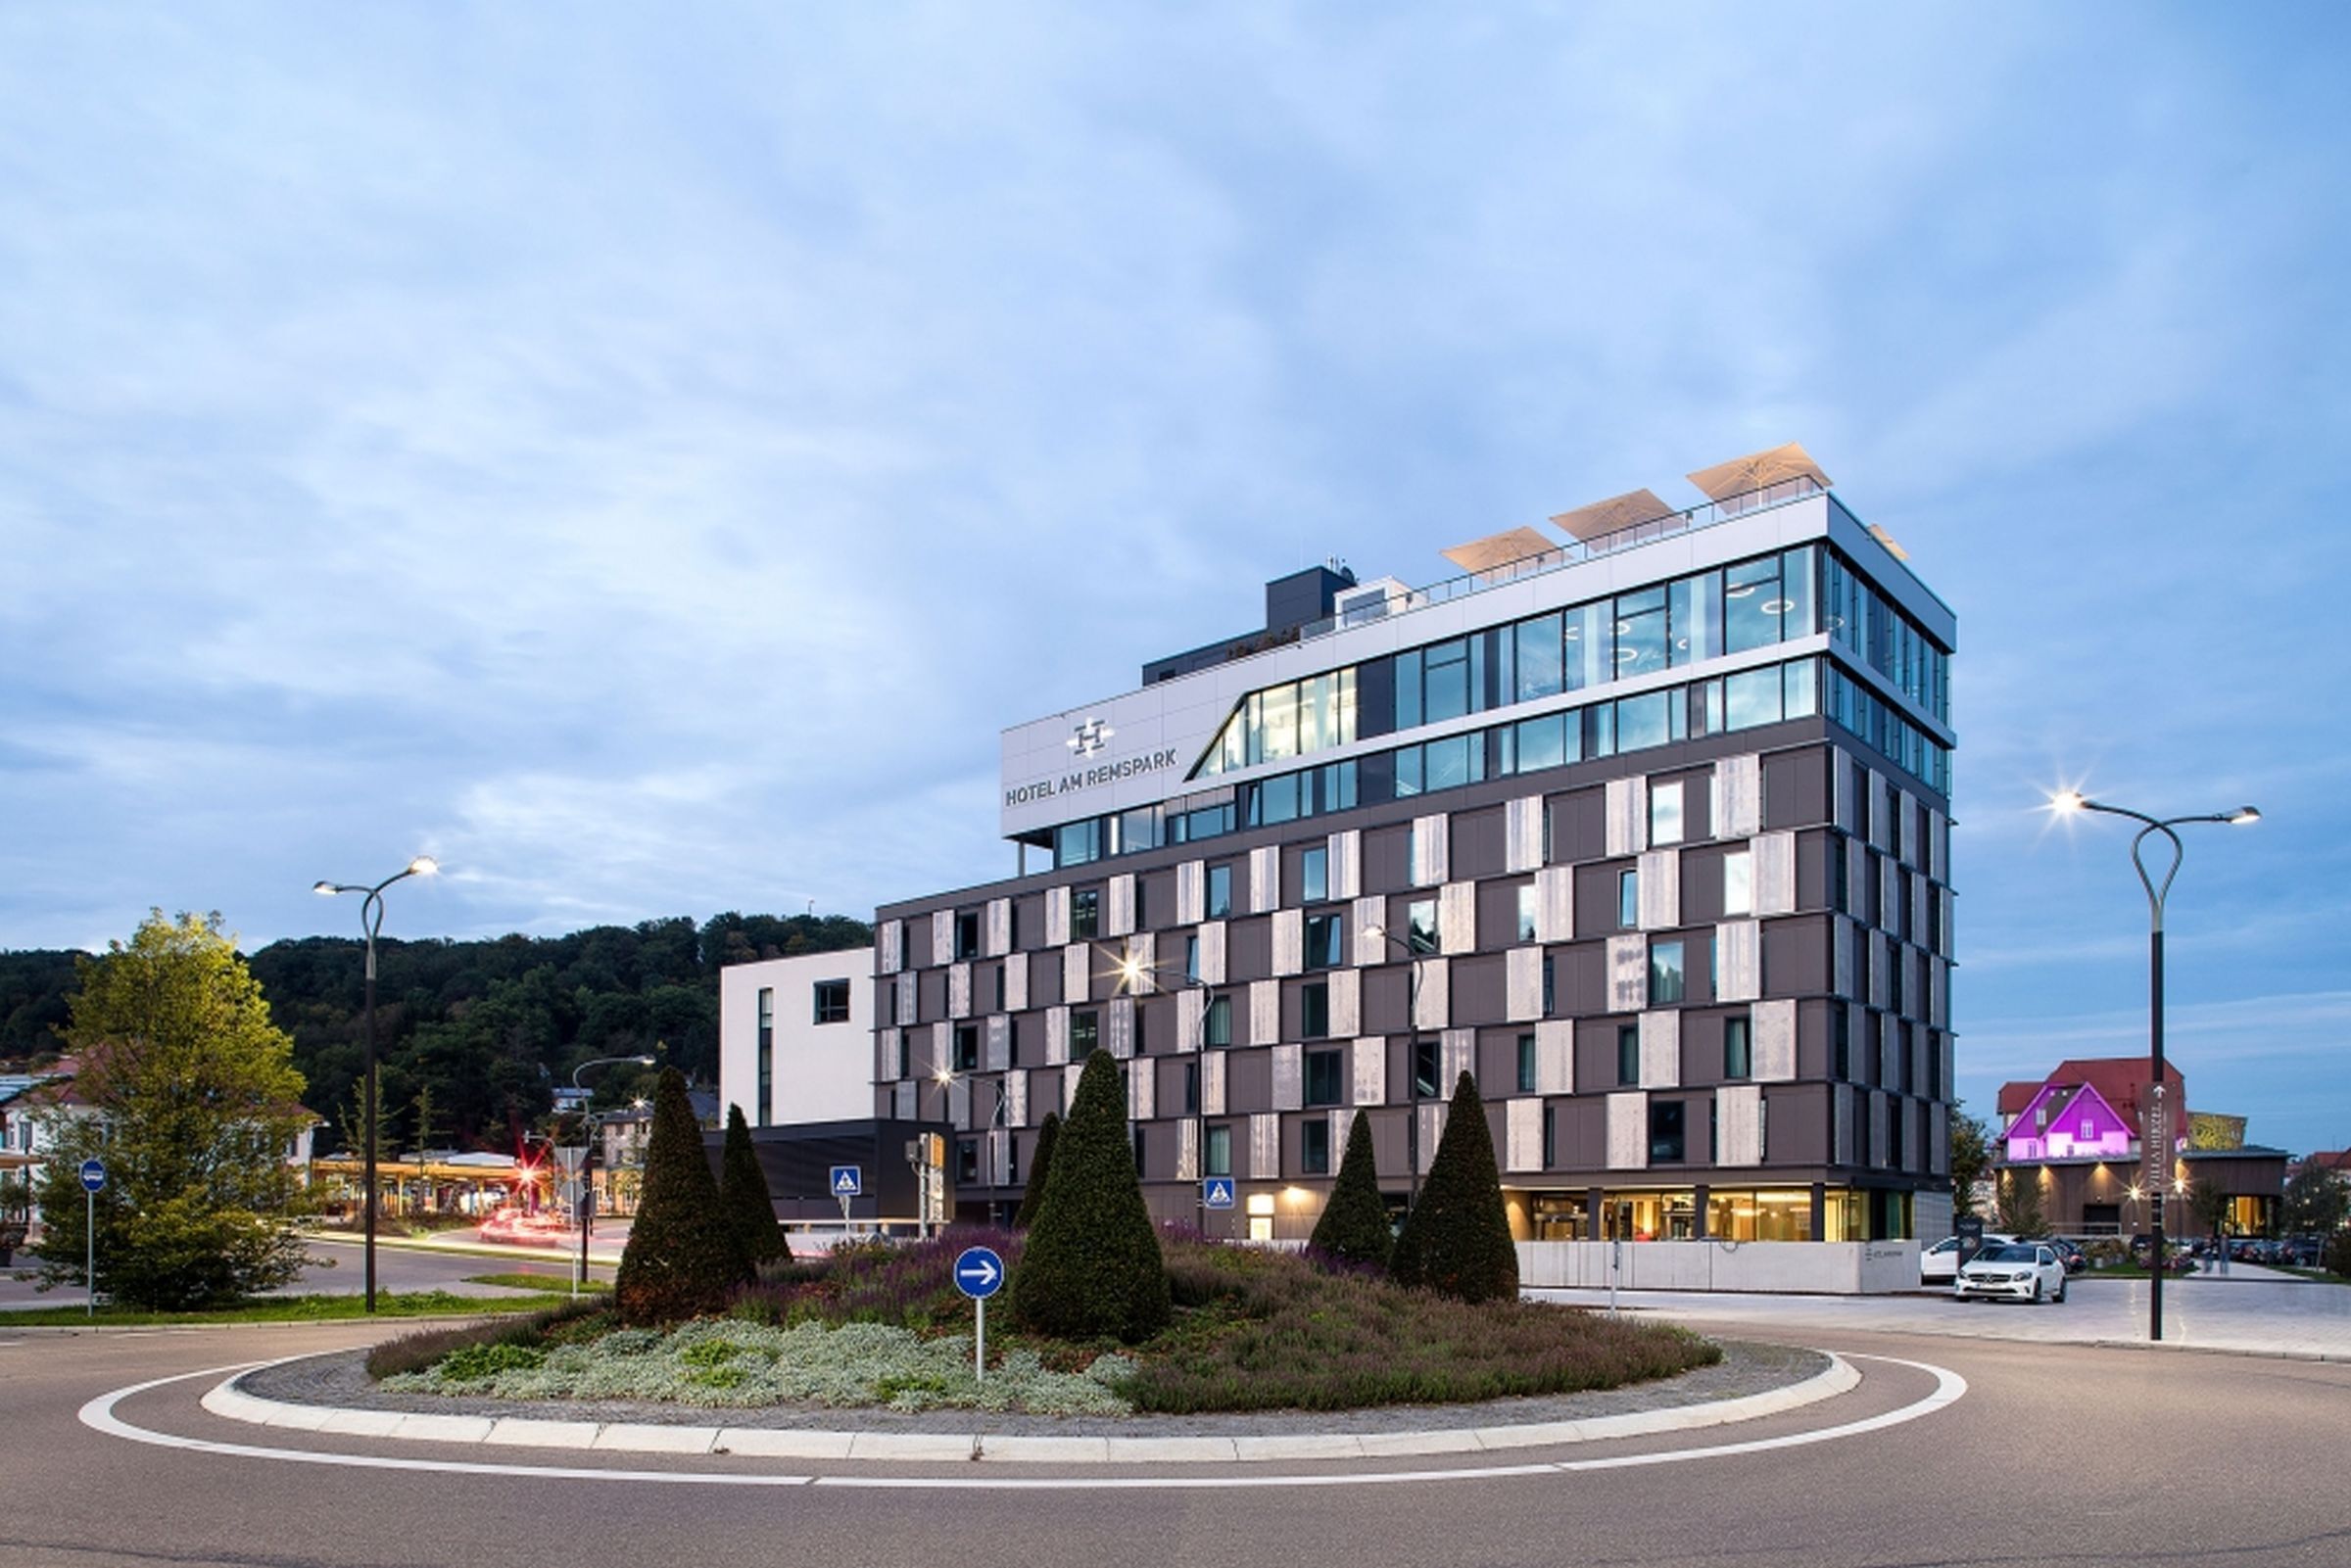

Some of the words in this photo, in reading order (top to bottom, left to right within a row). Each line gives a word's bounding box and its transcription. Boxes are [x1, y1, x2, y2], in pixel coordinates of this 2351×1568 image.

[1006, 780, 1056, 807] HOTEL
[1059, 773, 1082, 793] AM
[1087, 748, 1176, 786] REMSPARK
[2149, 1151, 2161, 1187] VILLA
